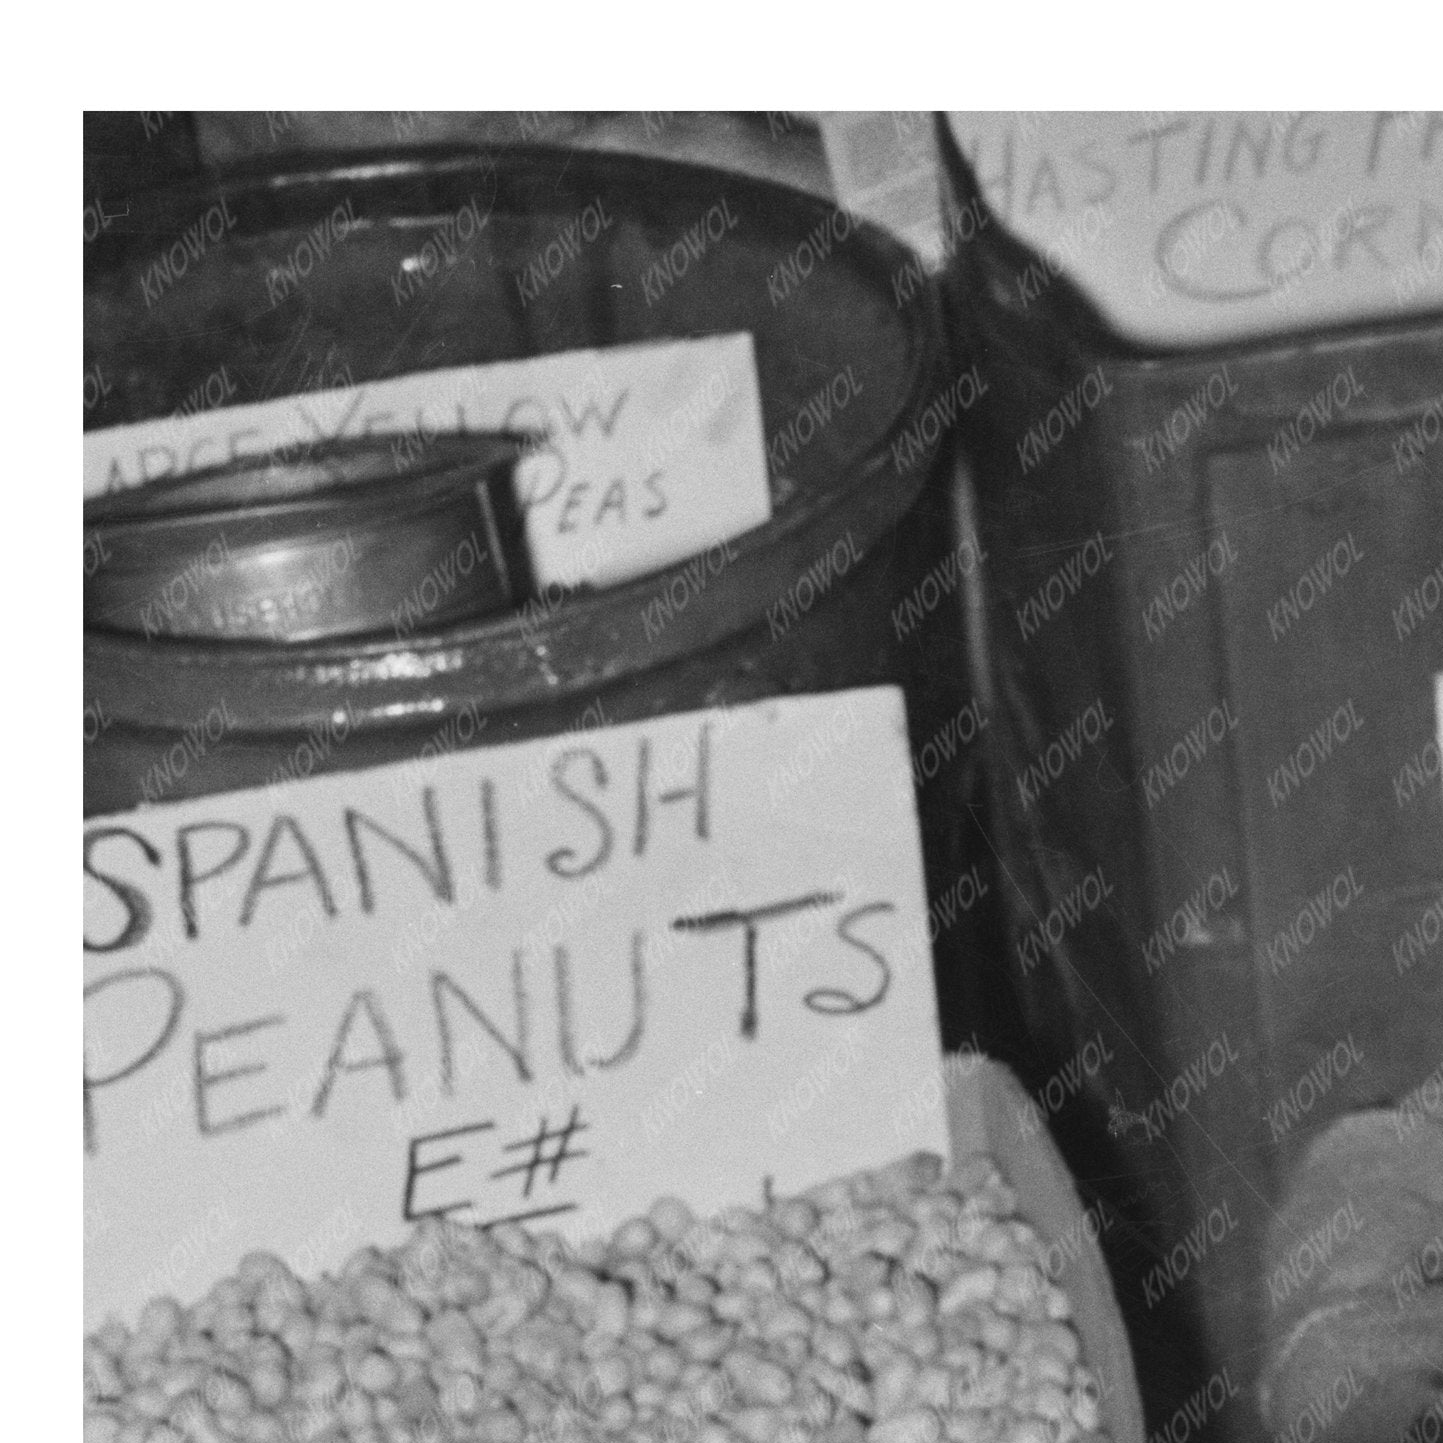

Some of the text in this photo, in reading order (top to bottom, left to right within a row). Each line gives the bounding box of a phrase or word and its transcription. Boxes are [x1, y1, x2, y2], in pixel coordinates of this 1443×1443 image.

[518, 445, 668, 534] PEAS
[80, 722, 711, 953] SPANISH
[80, 894, 898, 1158] PEANUTS
